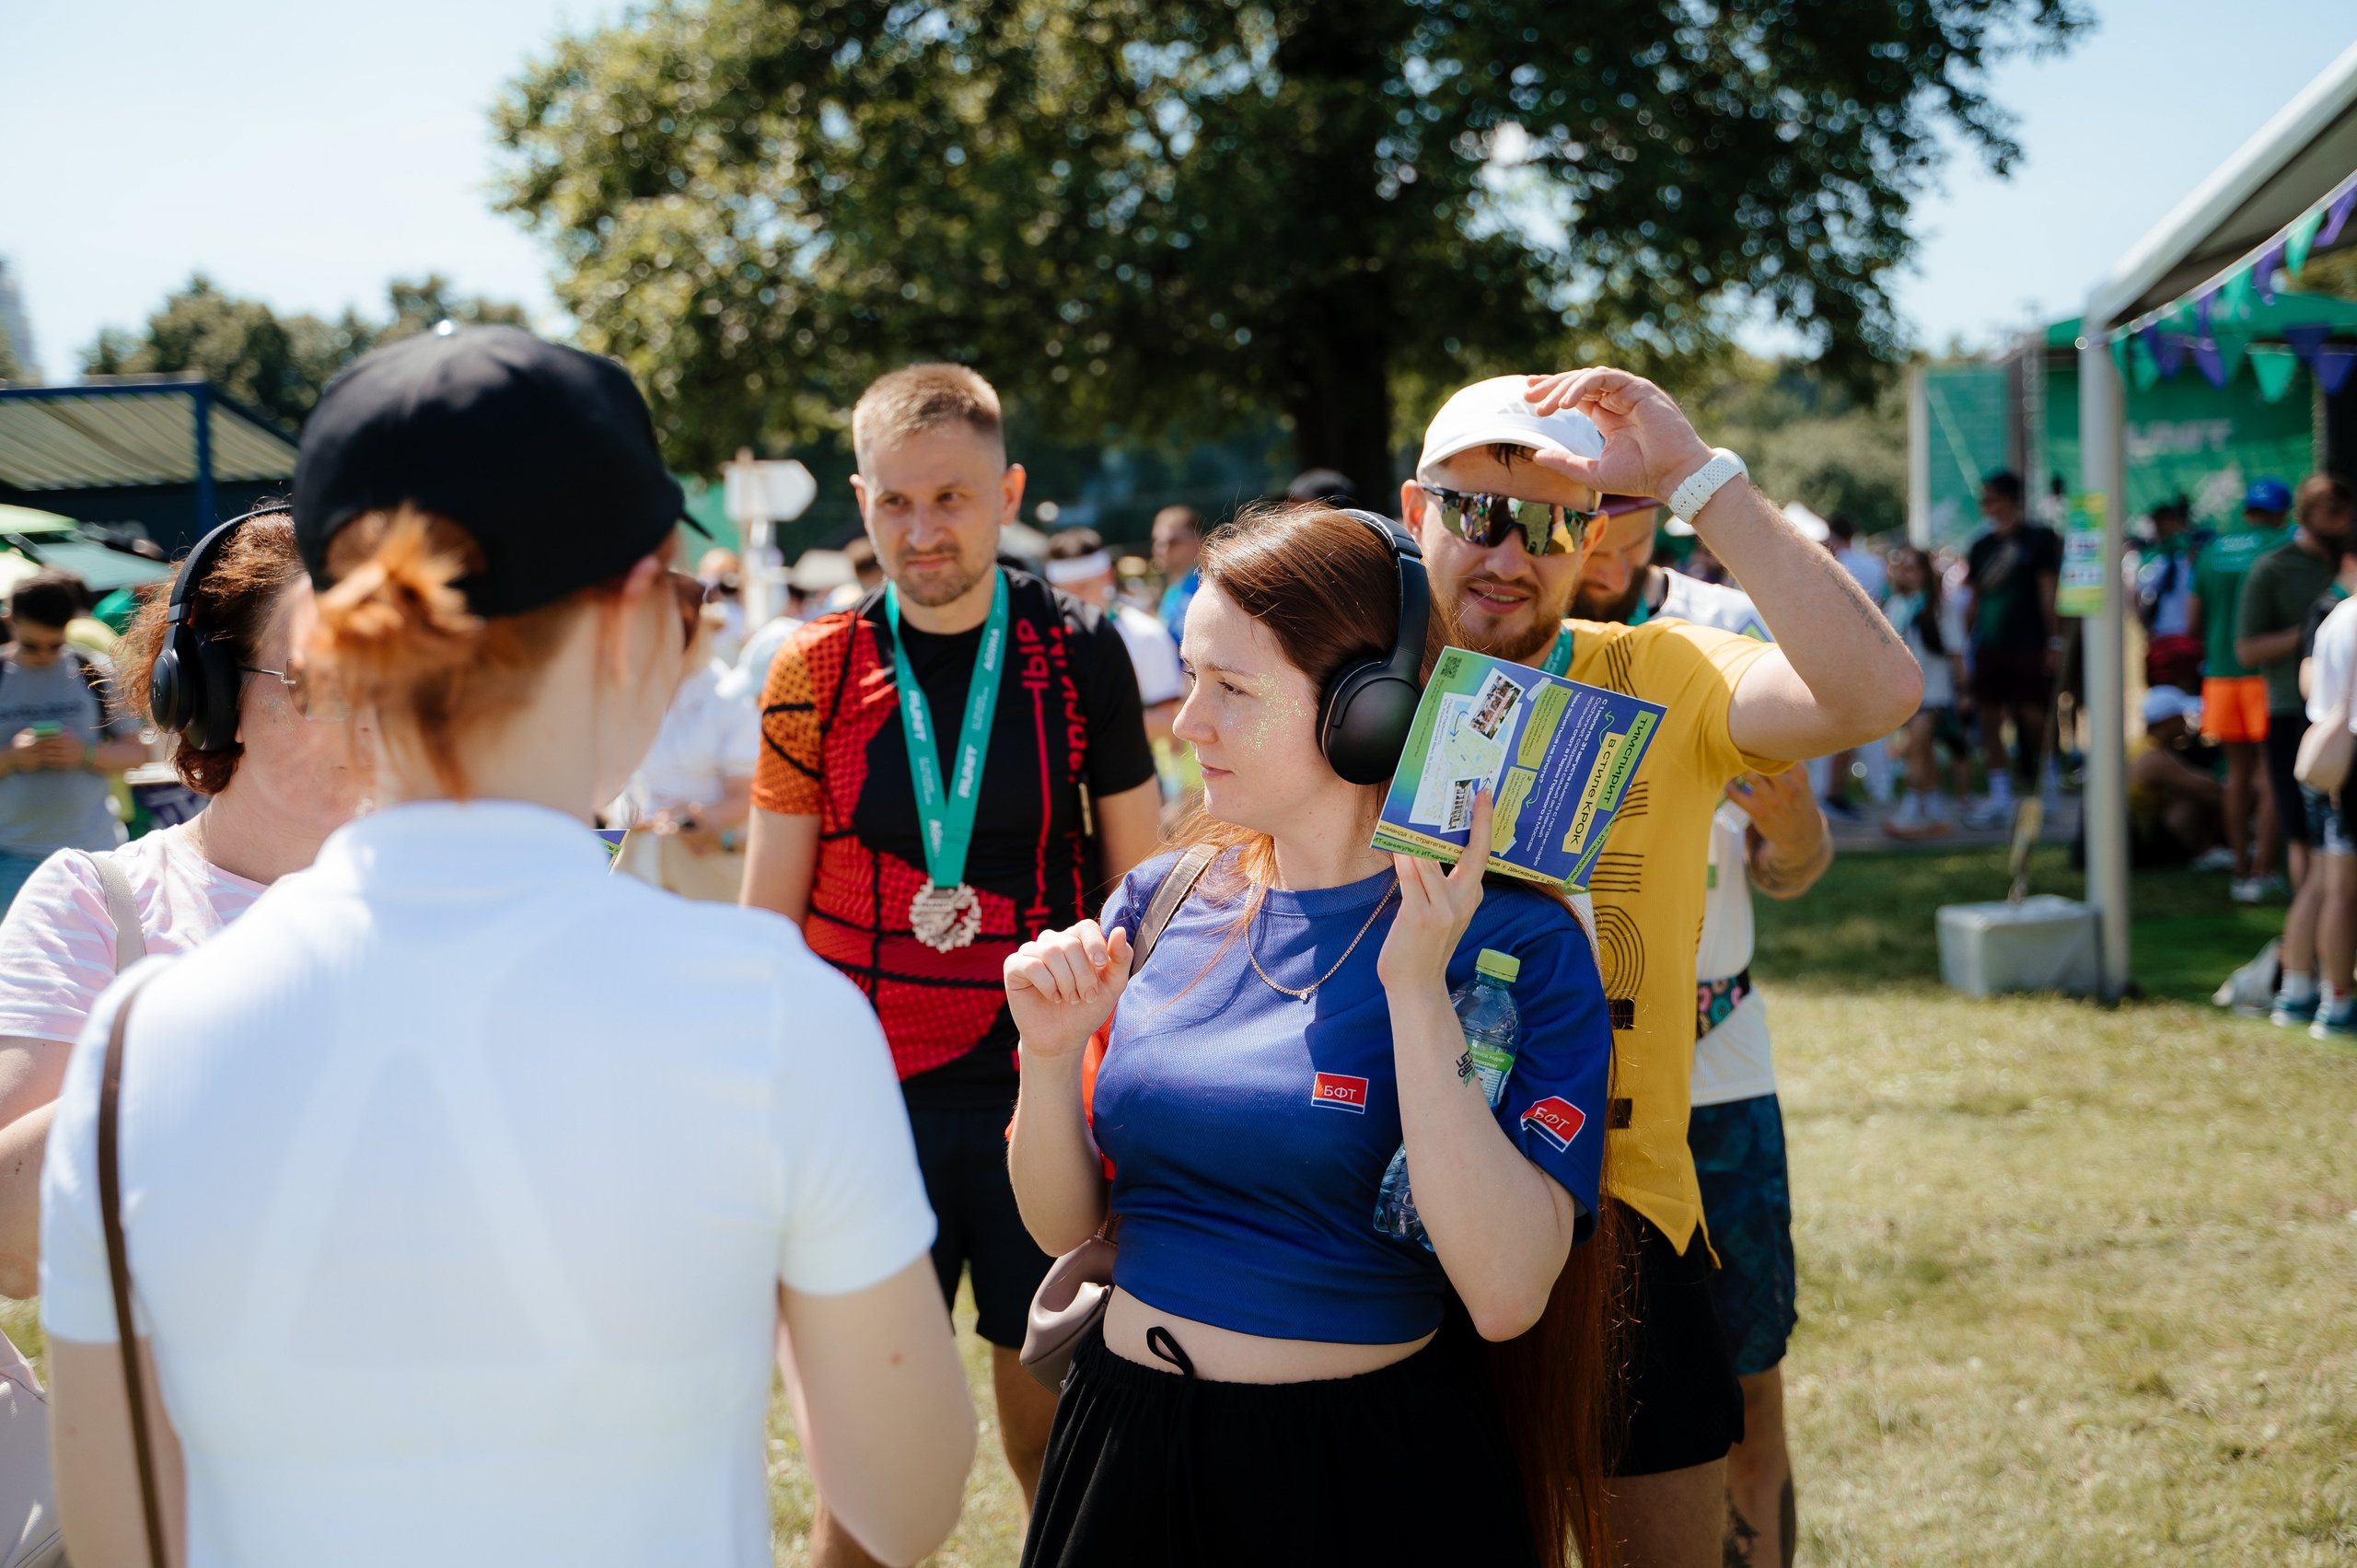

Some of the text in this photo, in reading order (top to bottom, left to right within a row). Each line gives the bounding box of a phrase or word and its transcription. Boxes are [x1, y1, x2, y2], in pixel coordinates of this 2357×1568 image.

[1574, 694, 1596, 728] зеленый
[1587, 709, 1601, 730] июля
[1537, 691, 1582, 784] Чем заняться на споте?
[1566, 727, 1578, 748] спот
[1578, 740, 1587, 750] 31
[1583, 730, 1592, 741] по
[1537, 696, 1602, 838] Cochonnet создаем самый активный
[1552, 753, 1568, 779] Парке
[1564, 749, 1583, 782] августа
[1605, 718, 1647, 803] тимспирит
[1538, 778, 1558, 815] Горького
[1553, 781, 1570, 811] вместе
[1570, 738, 1617, 845] в стиле КРОК
[1377, 823, 1408, 837] команда
[1413, 835, 1447, 850] стратегия
[1506, 865, 1540, 880] движение
[1525, 820, 1541, 852] Москве
[1532, 817, 1555, 866] петанк-кафе
[1569, 833, 1606, 878] ИТ-каникулы
[1323, 1085, 1357, 1100] БФТ
[1533, 1107, 1571, 1131] БФТ
